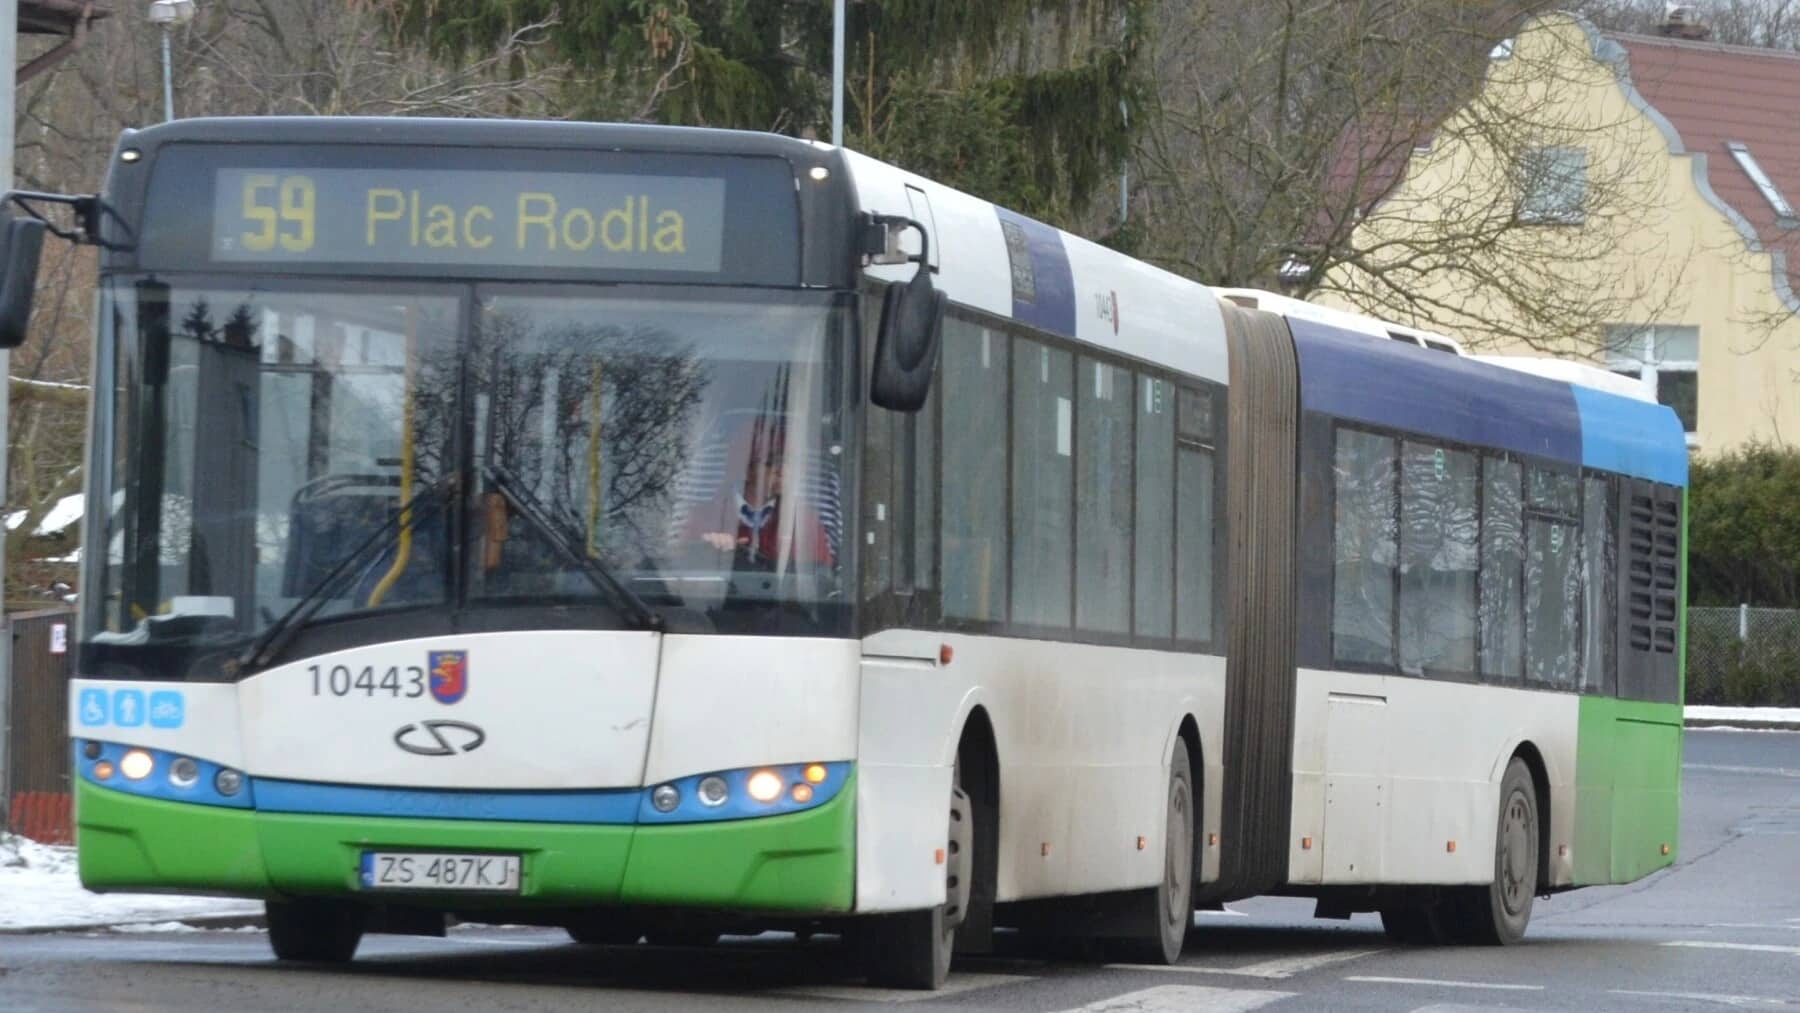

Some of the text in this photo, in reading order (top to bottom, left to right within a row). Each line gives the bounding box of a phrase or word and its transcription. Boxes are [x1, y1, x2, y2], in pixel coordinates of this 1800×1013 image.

[242, 174, 686, 253] 59 Plac Rodla
[307, 664, 425, 698] 10443
[379, 857, 509, 886] ZS 487KJ
